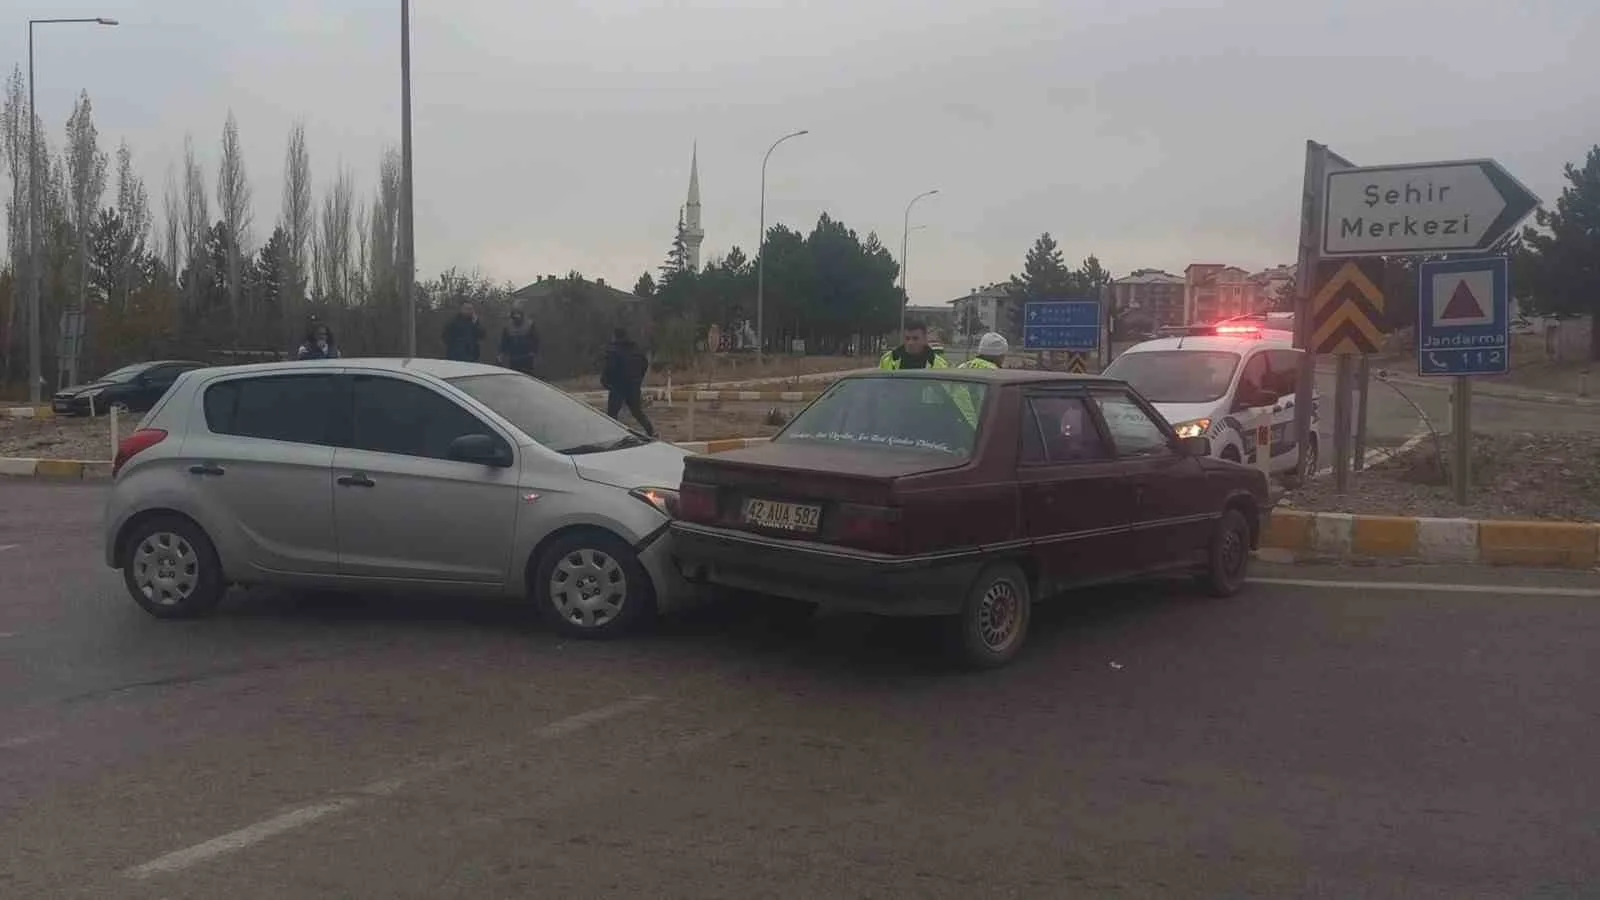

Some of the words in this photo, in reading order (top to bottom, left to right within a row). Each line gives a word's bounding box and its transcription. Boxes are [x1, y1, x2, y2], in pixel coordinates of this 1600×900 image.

[1365, 183, 1451, 208] Şehir
[1341, 214, 1470, 239] Merkezi
[1424, 333, 1505, 347] Jandarma
[1462, 351, 1501, 364] 112
[750, 501, 764, 518] 42
[767, 504, 790, 521] AUA
[794, 507, 818, 526] 582
